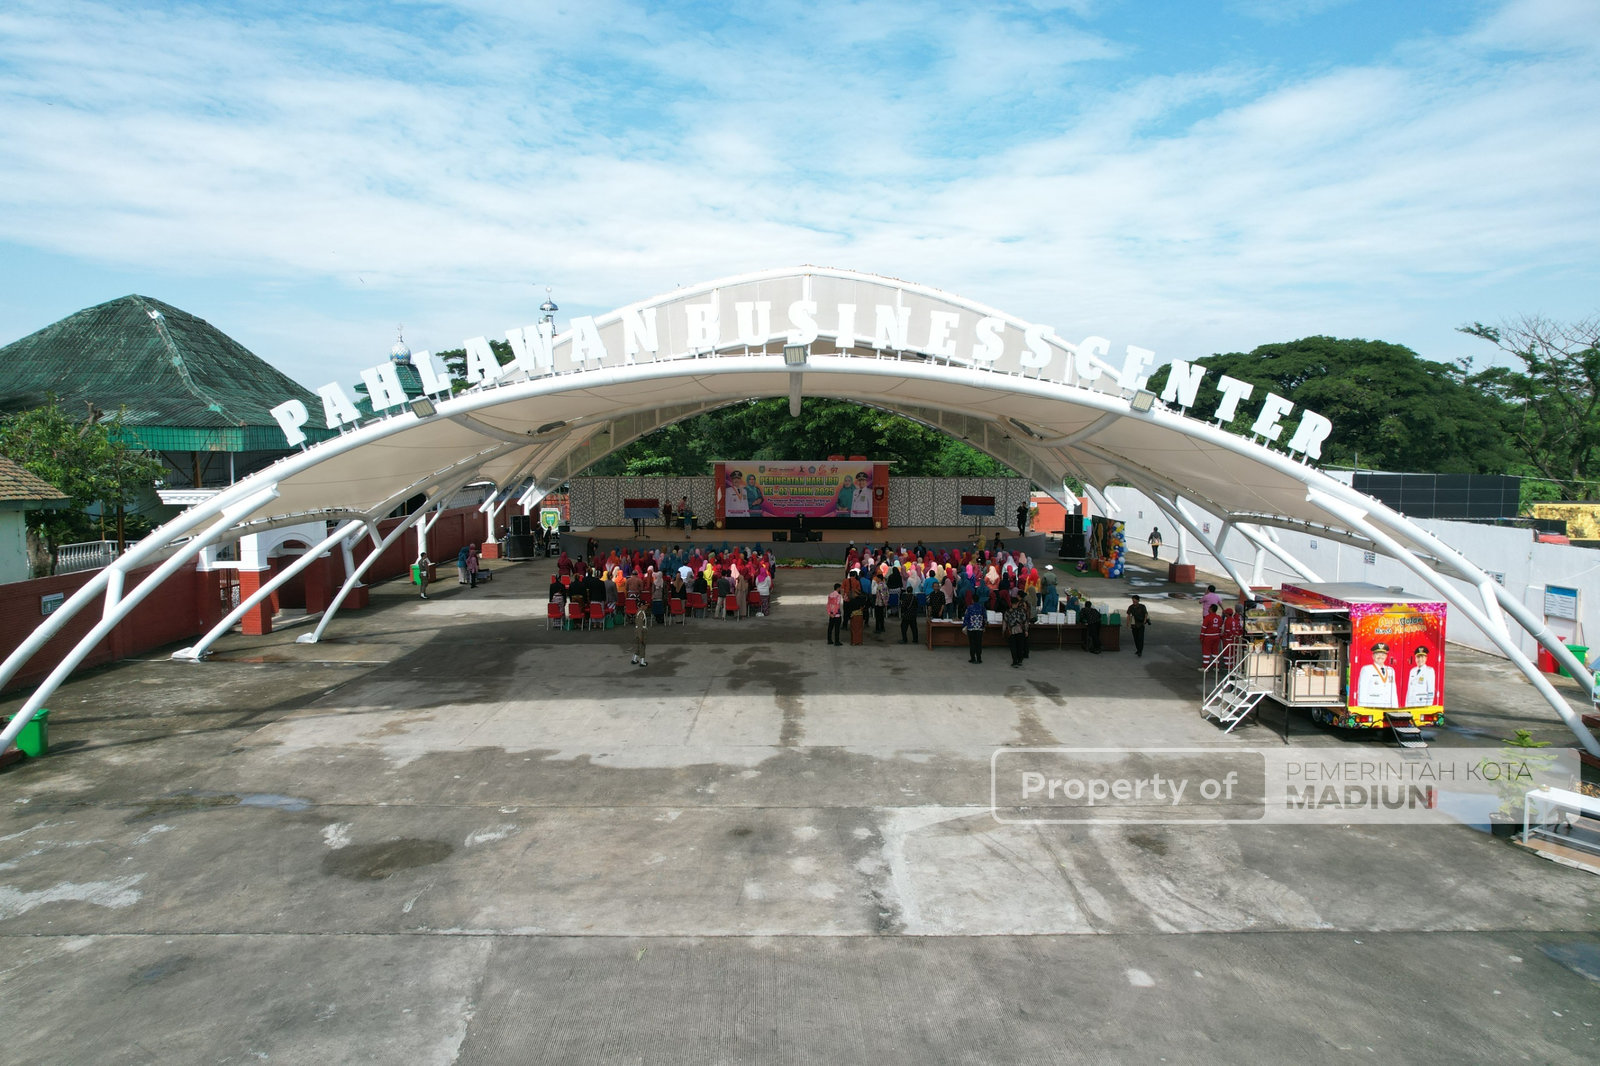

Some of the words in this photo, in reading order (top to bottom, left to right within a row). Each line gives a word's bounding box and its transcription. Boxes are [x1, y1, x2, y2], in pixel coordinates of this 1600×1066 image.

[270, 307, 658, 447] PAHLAWAN
[685, 300, 1055, 369] BUSINESS
[1075, 336, 1333, 461] CENTER
